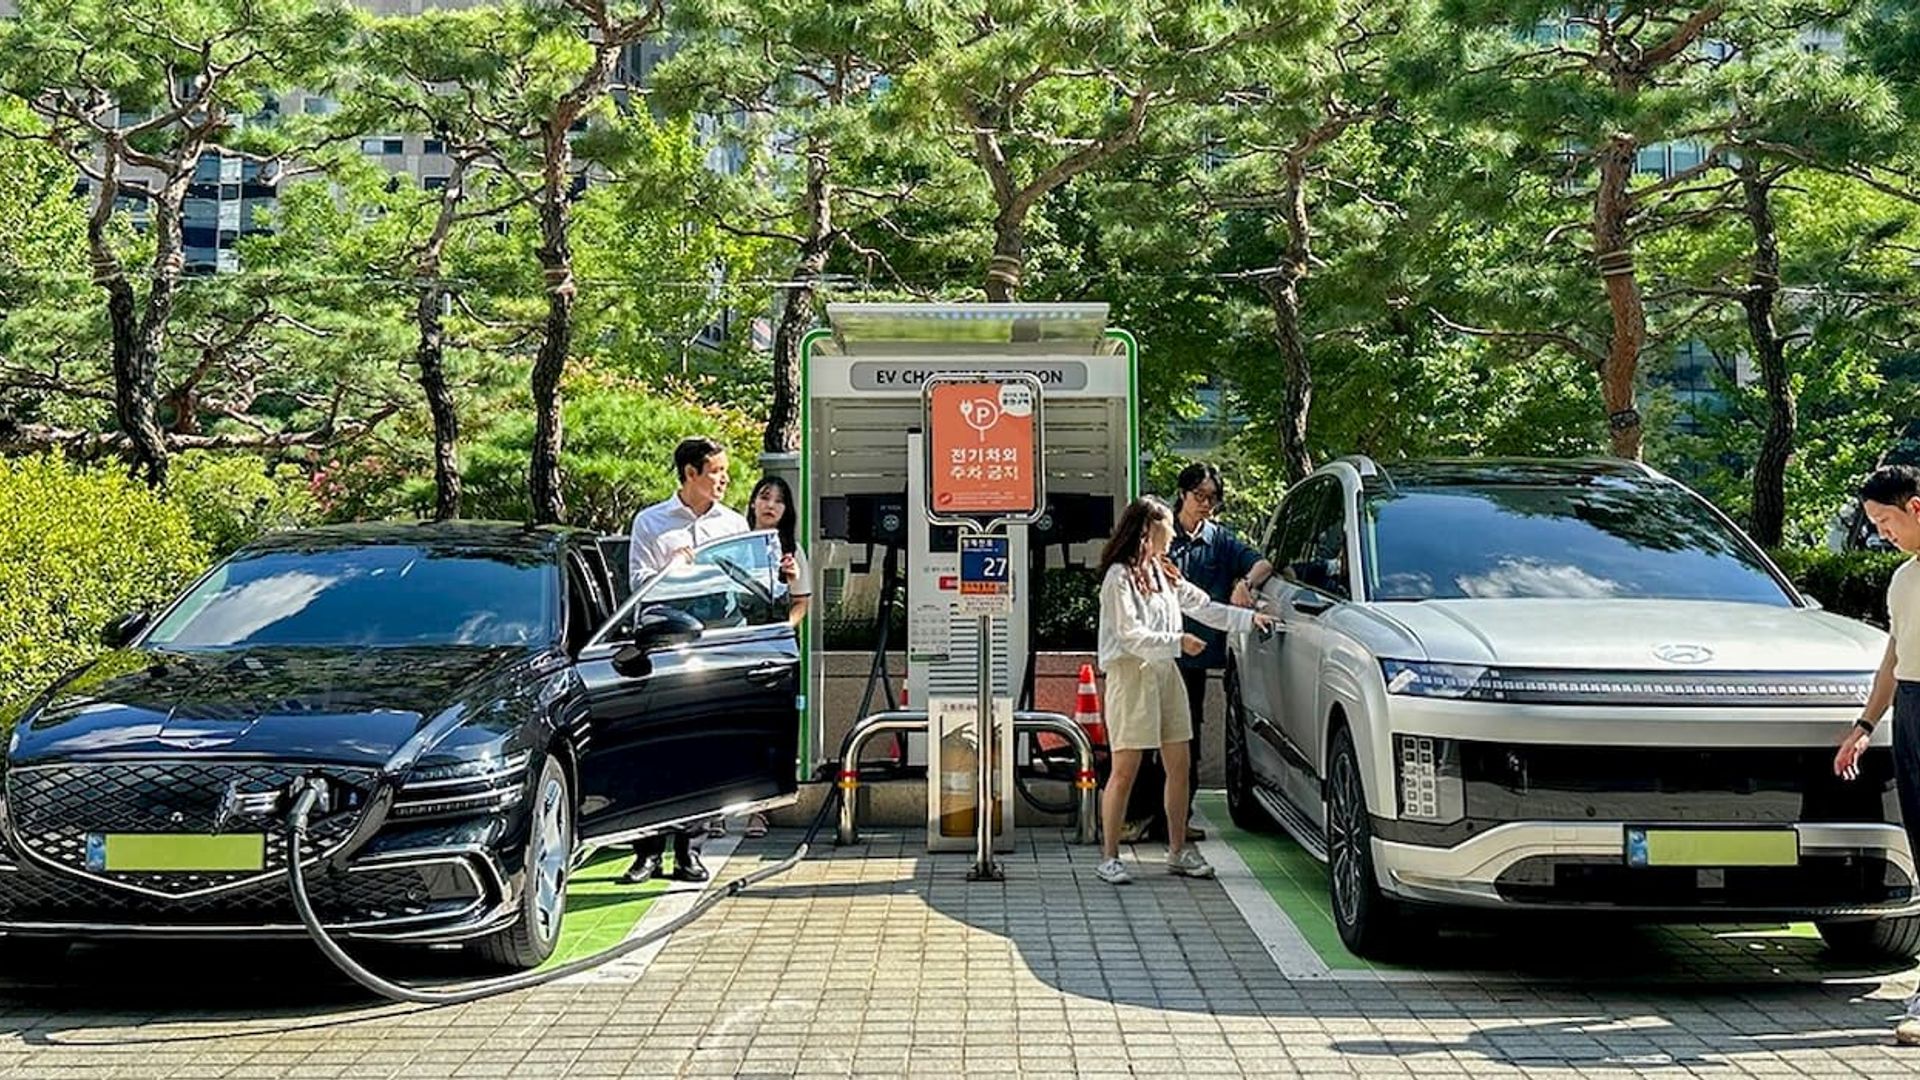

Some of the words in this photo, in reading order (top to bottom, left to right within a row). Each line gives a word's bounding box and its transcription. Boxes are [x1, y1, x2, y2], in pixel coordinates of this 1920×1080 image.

[876, 370, 897, 384] EV
[976, 407, 991, 424] P
[950, 447, 1017, 463] 전기차외
[950, 465, 982, 480] 주차
[987, 465, 1019, 480] 금지
[983, 556, 1007, 577] 27
